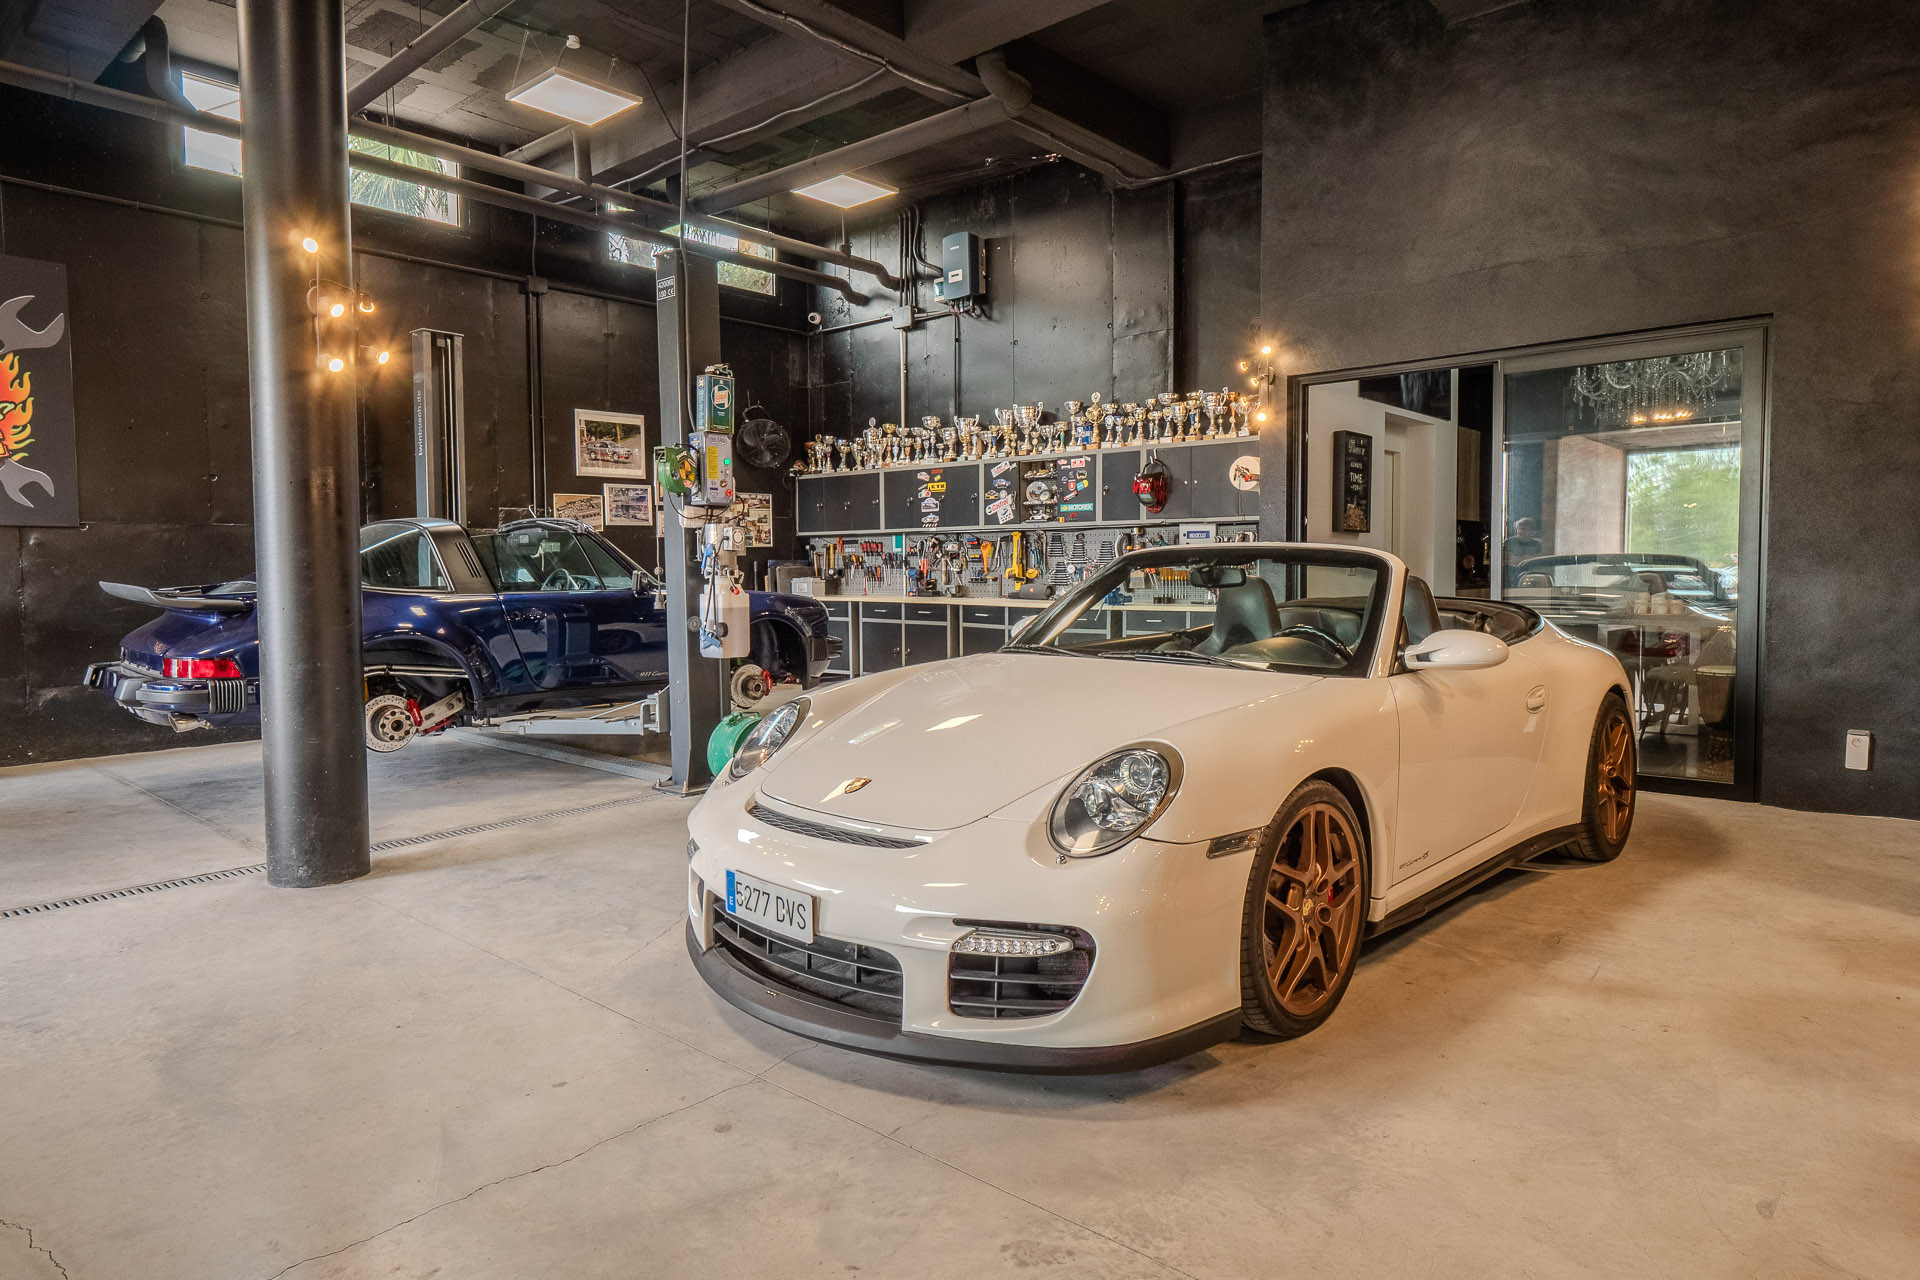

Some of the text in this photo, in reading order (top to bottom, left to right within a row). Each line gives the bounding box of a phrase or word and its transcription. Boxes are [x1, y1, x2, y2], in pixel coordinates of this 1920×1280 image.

[1349, 472, 1363, 483] TIME
[736, 880, 806, 930] 5277 DVS
